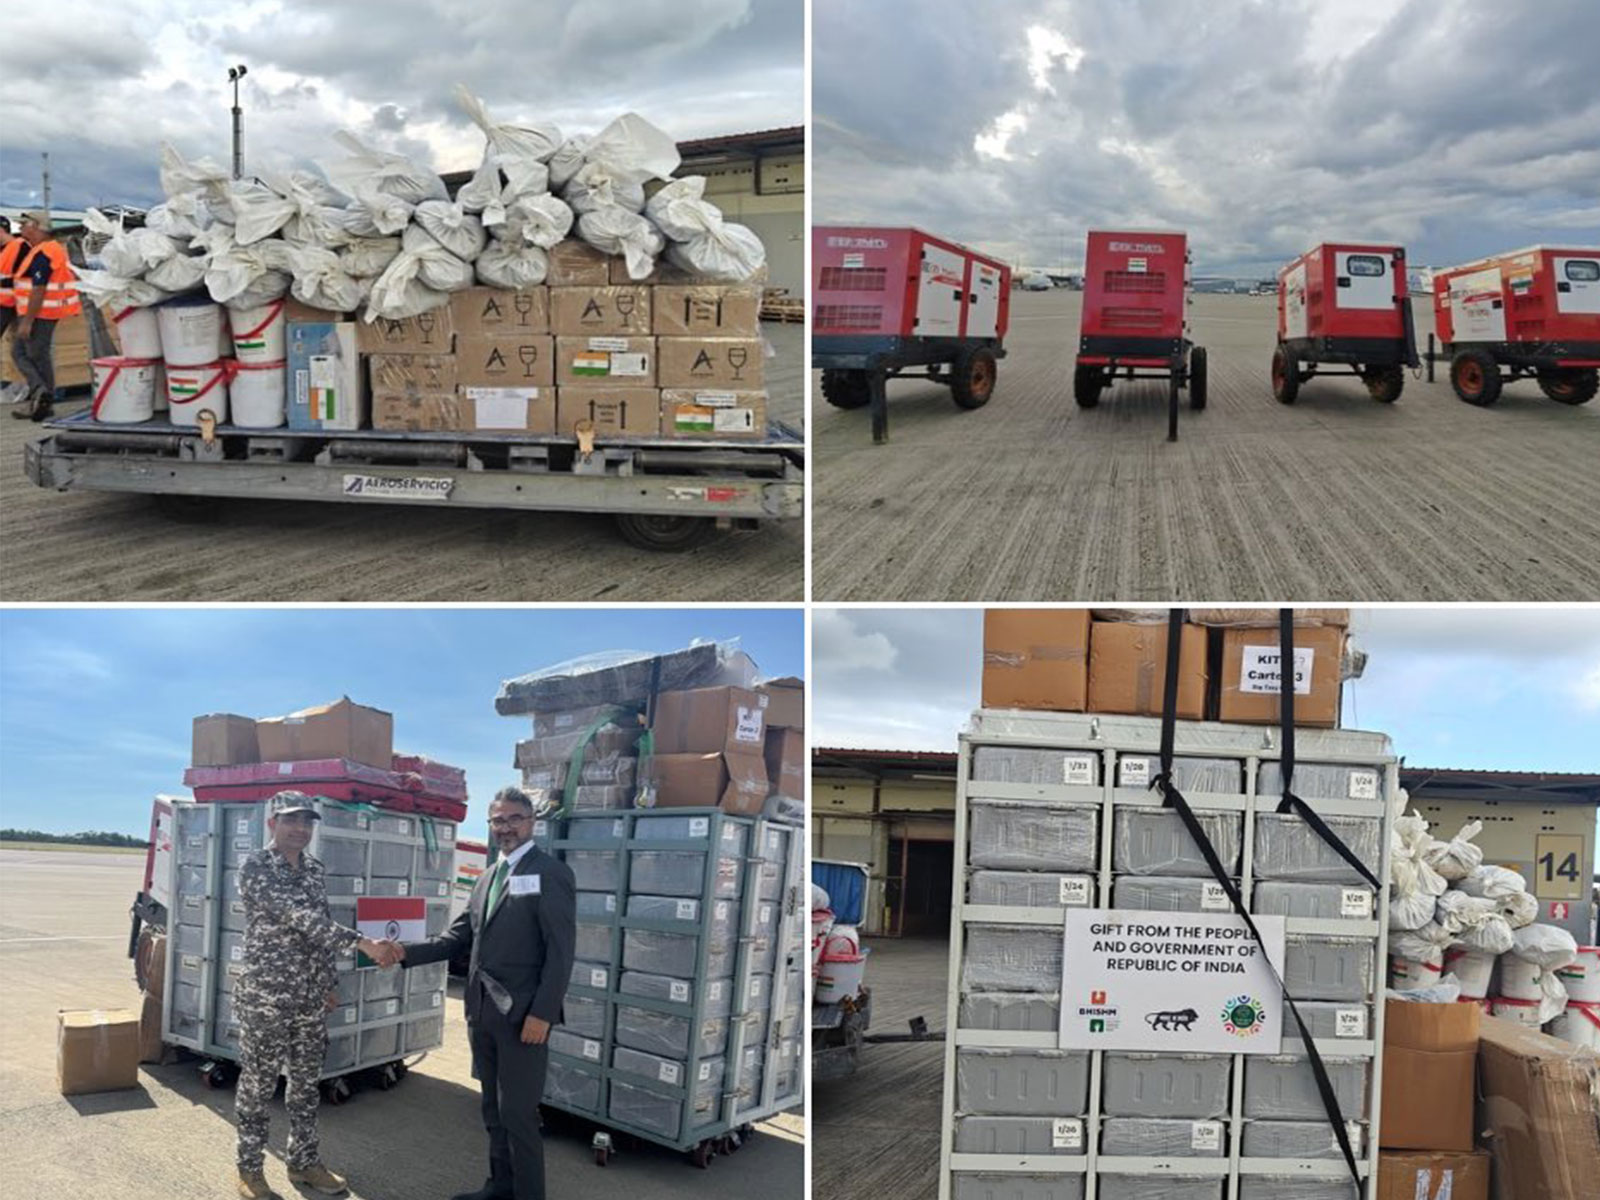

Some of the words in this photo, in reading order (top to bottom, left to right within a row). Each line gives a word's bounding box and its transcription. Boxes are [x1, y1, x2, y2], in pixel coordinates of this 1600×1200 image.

[1295, 672, 1303, 682] 3
[1538, 852, 1580, 882] 14
[1090, 923, 1123, 936] GIFT
[1127, 924, 1170, 938] FROM
[1174, 926, 1202, 939] THE
[1092, 940, 1126, 953] AND
[1129, 941, 1235, 956] GOVERNMENT
[1237, 945, 1257, 957] OF
[1106, 957, 1178, 972] REPUBLIC
[1181, 960, 1202, 972] OF
[1204, 961, 1246, 974] INDIA
